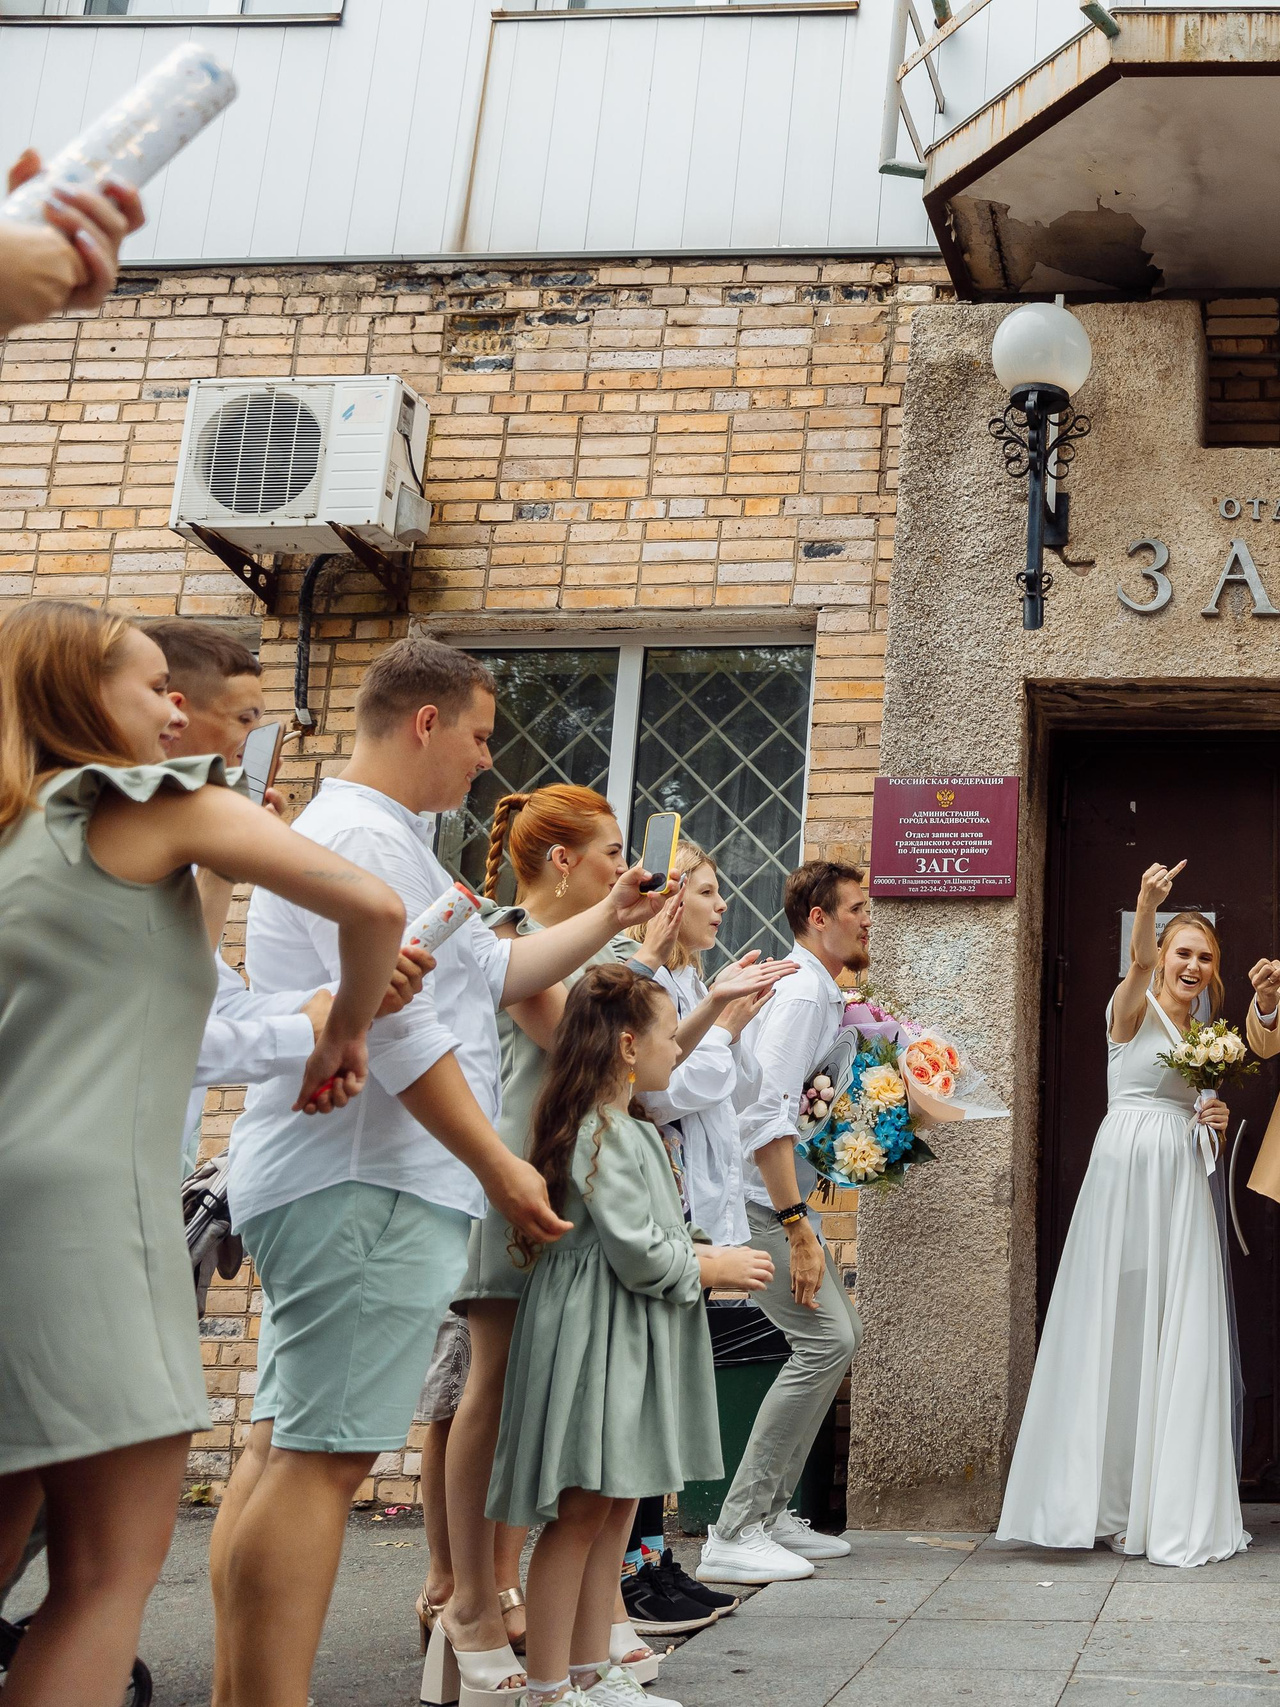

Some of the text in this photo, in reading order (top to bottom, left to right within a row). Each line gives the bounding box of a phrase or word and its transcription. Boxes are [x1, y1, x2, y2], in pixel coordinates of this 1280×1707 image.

[910, 847, 958, 855] Ленинскому
[961, 847, 989, 855] району
[915, 858, 970, 873] ЗАГС
